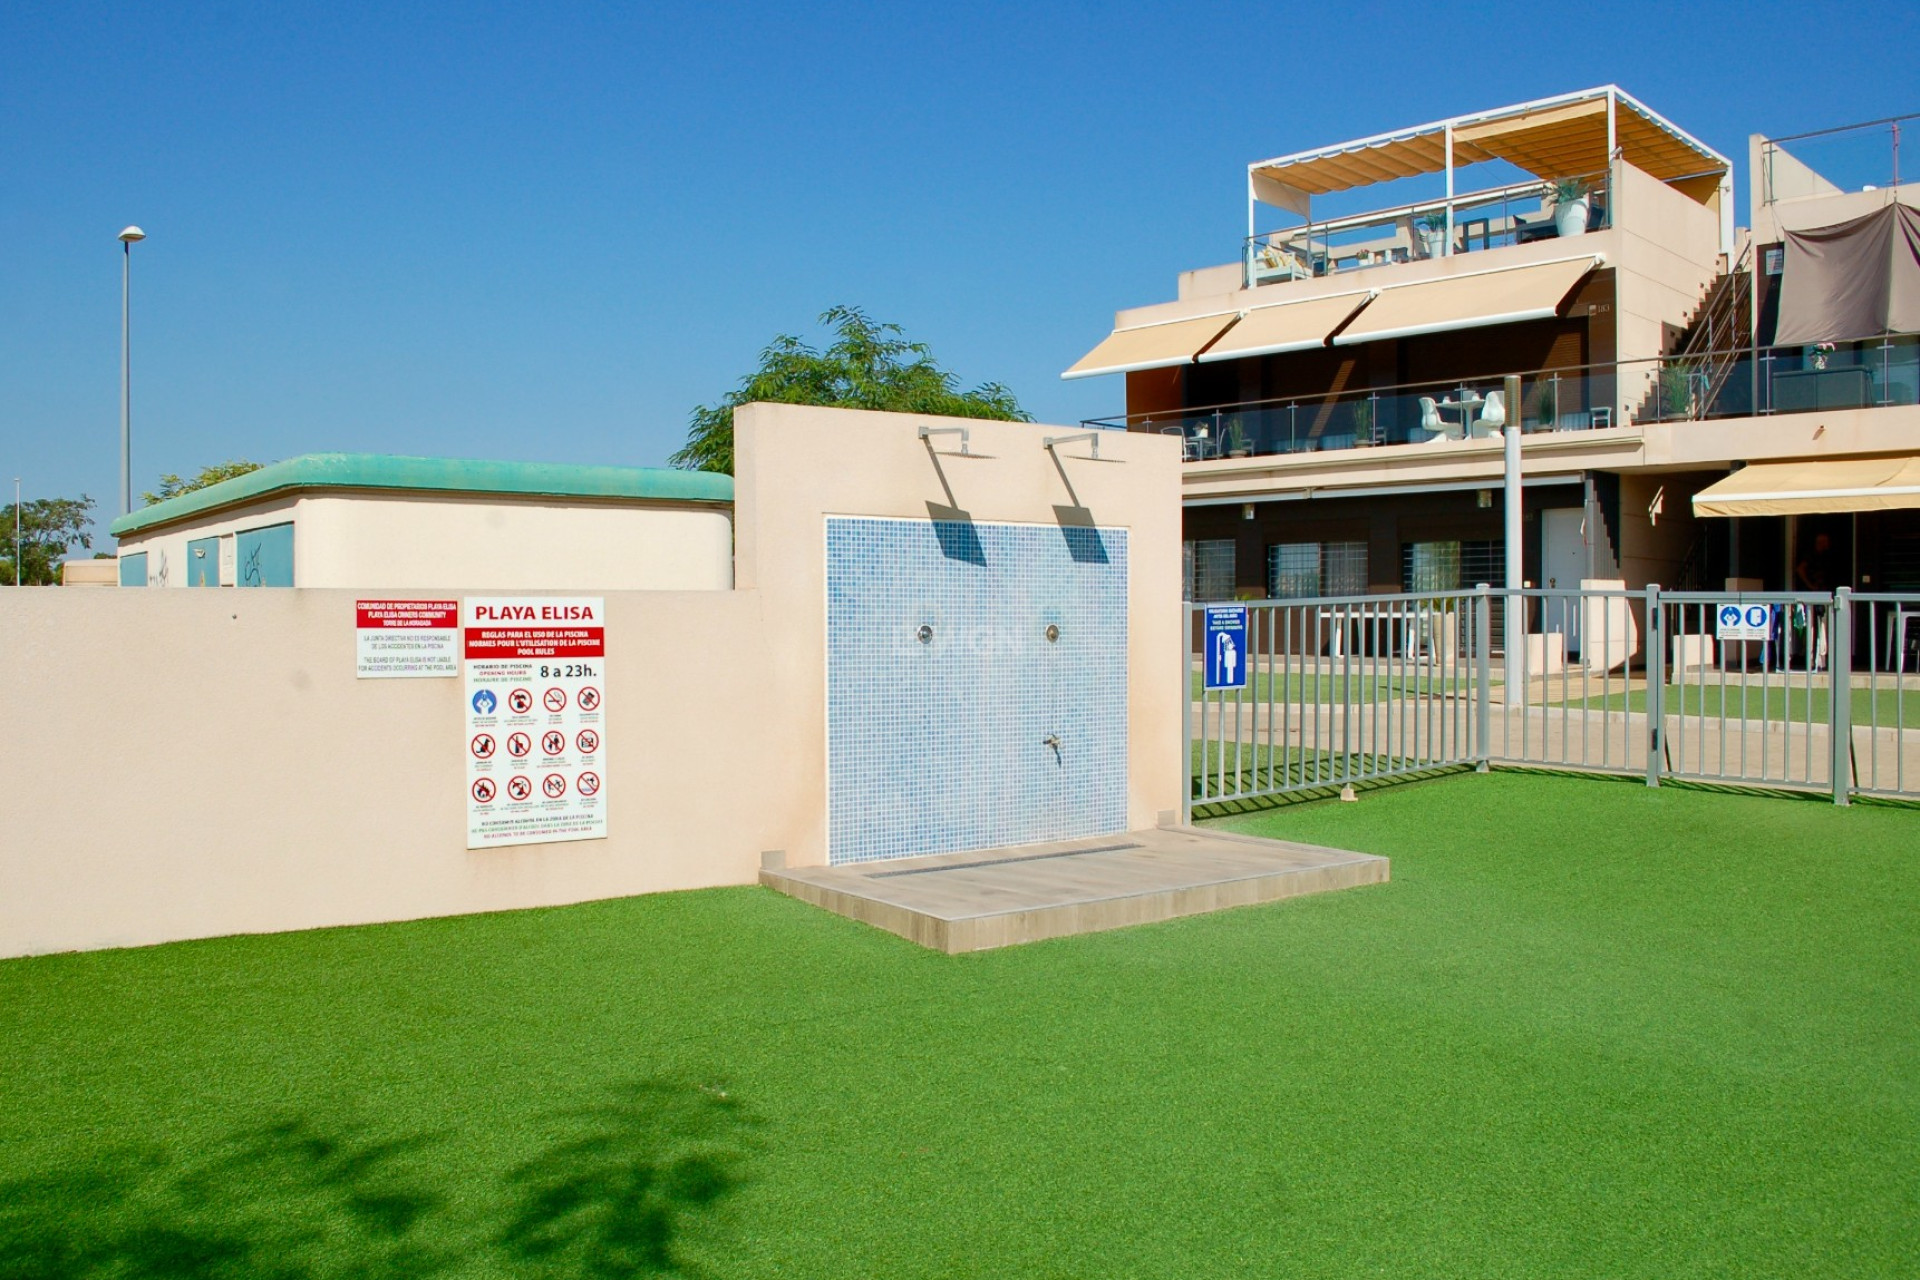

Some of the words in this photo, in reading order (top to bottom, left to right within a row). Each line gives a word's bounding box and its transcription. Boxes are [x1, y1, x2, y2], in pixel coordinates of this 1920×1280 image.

[476, 606, 535, 620] PLAYA
[542, 606, 593, 620] ELISA
[541, 666, 549, 677] 8
[553, 668, 561, 677] a
[566, 664, 596, 677] 23h.
